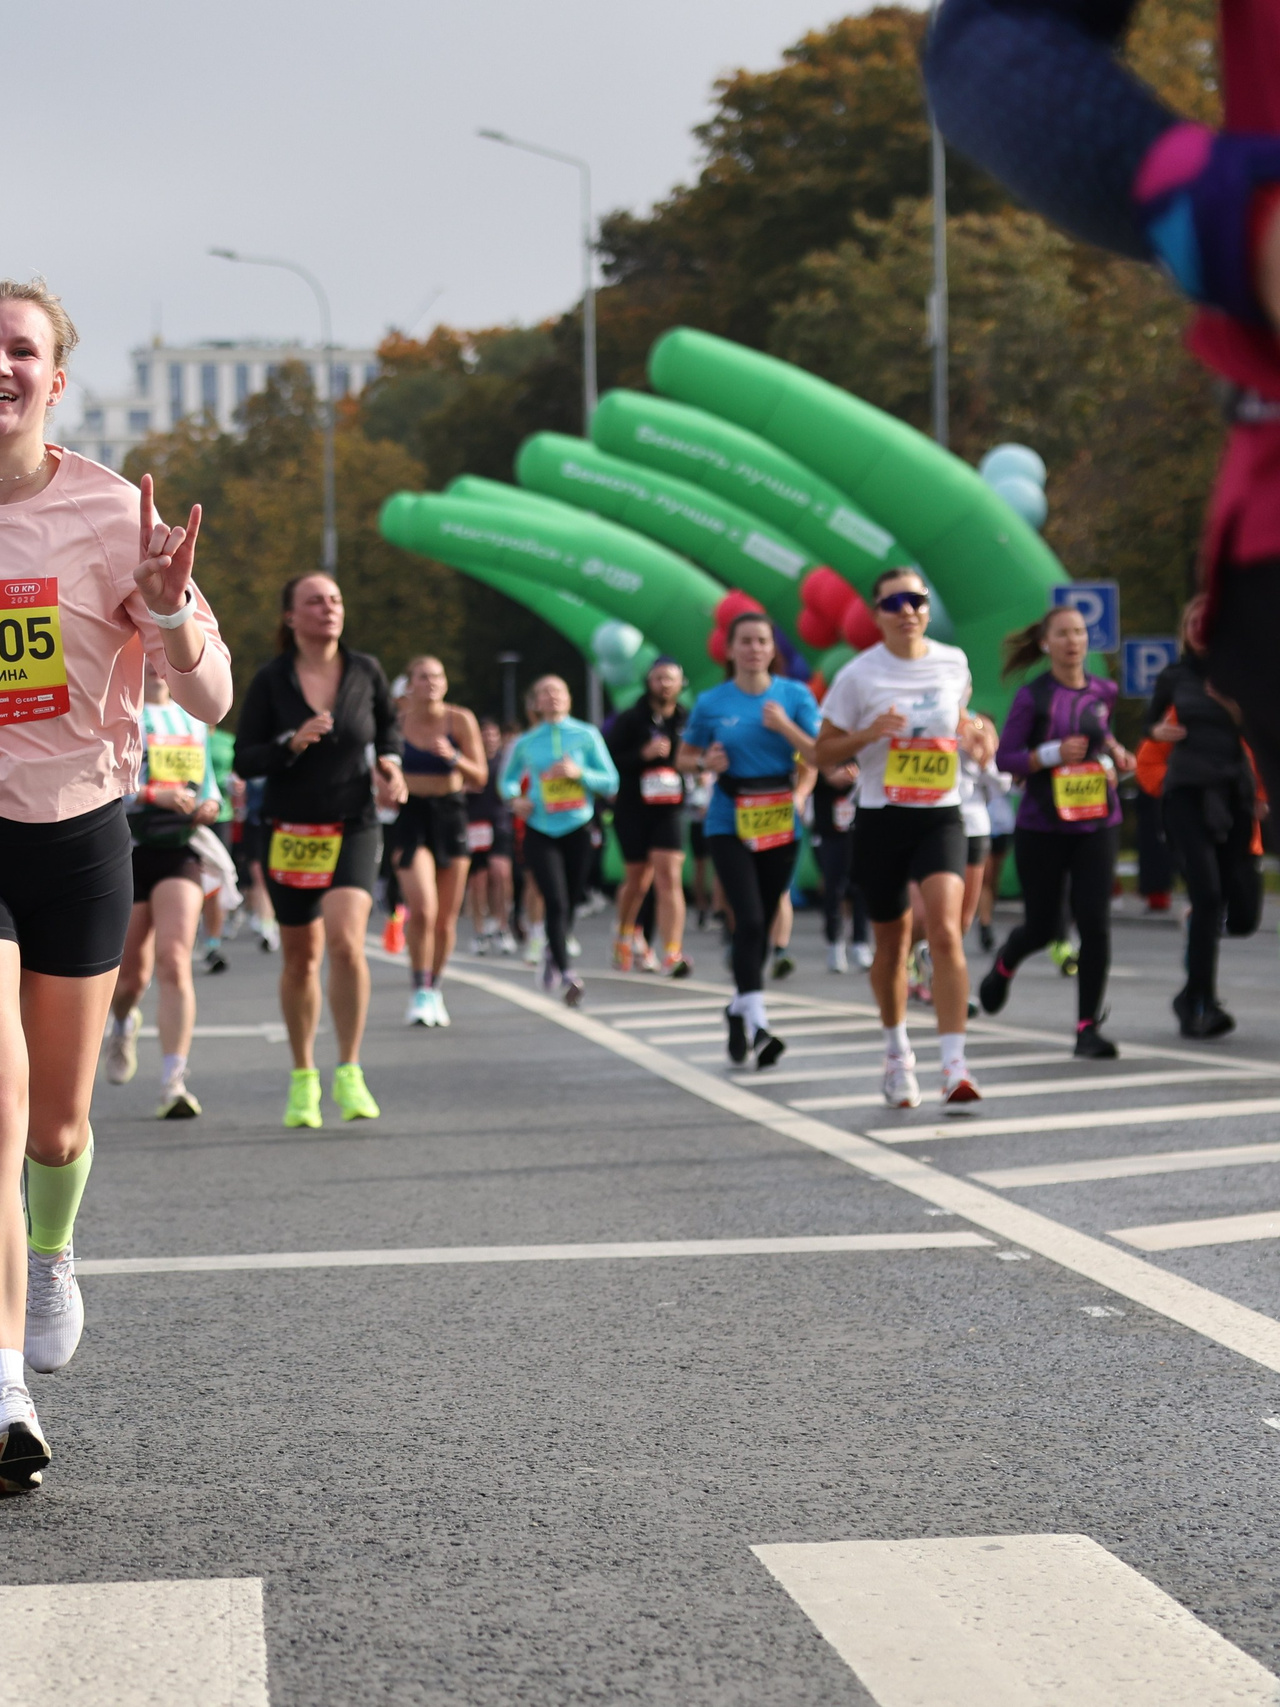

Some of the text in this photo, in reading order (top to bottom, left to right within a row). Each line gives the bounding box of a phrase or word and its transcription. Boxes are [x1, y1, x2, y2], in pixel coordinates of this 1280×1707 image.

[10, 585, 20, 593] 10
[11, 596, 35, 604] 2026
[1135, 645, 1168, 691] P
[898, 754, 949, 776] 7140
[281, 838, 333, 861] 9095
